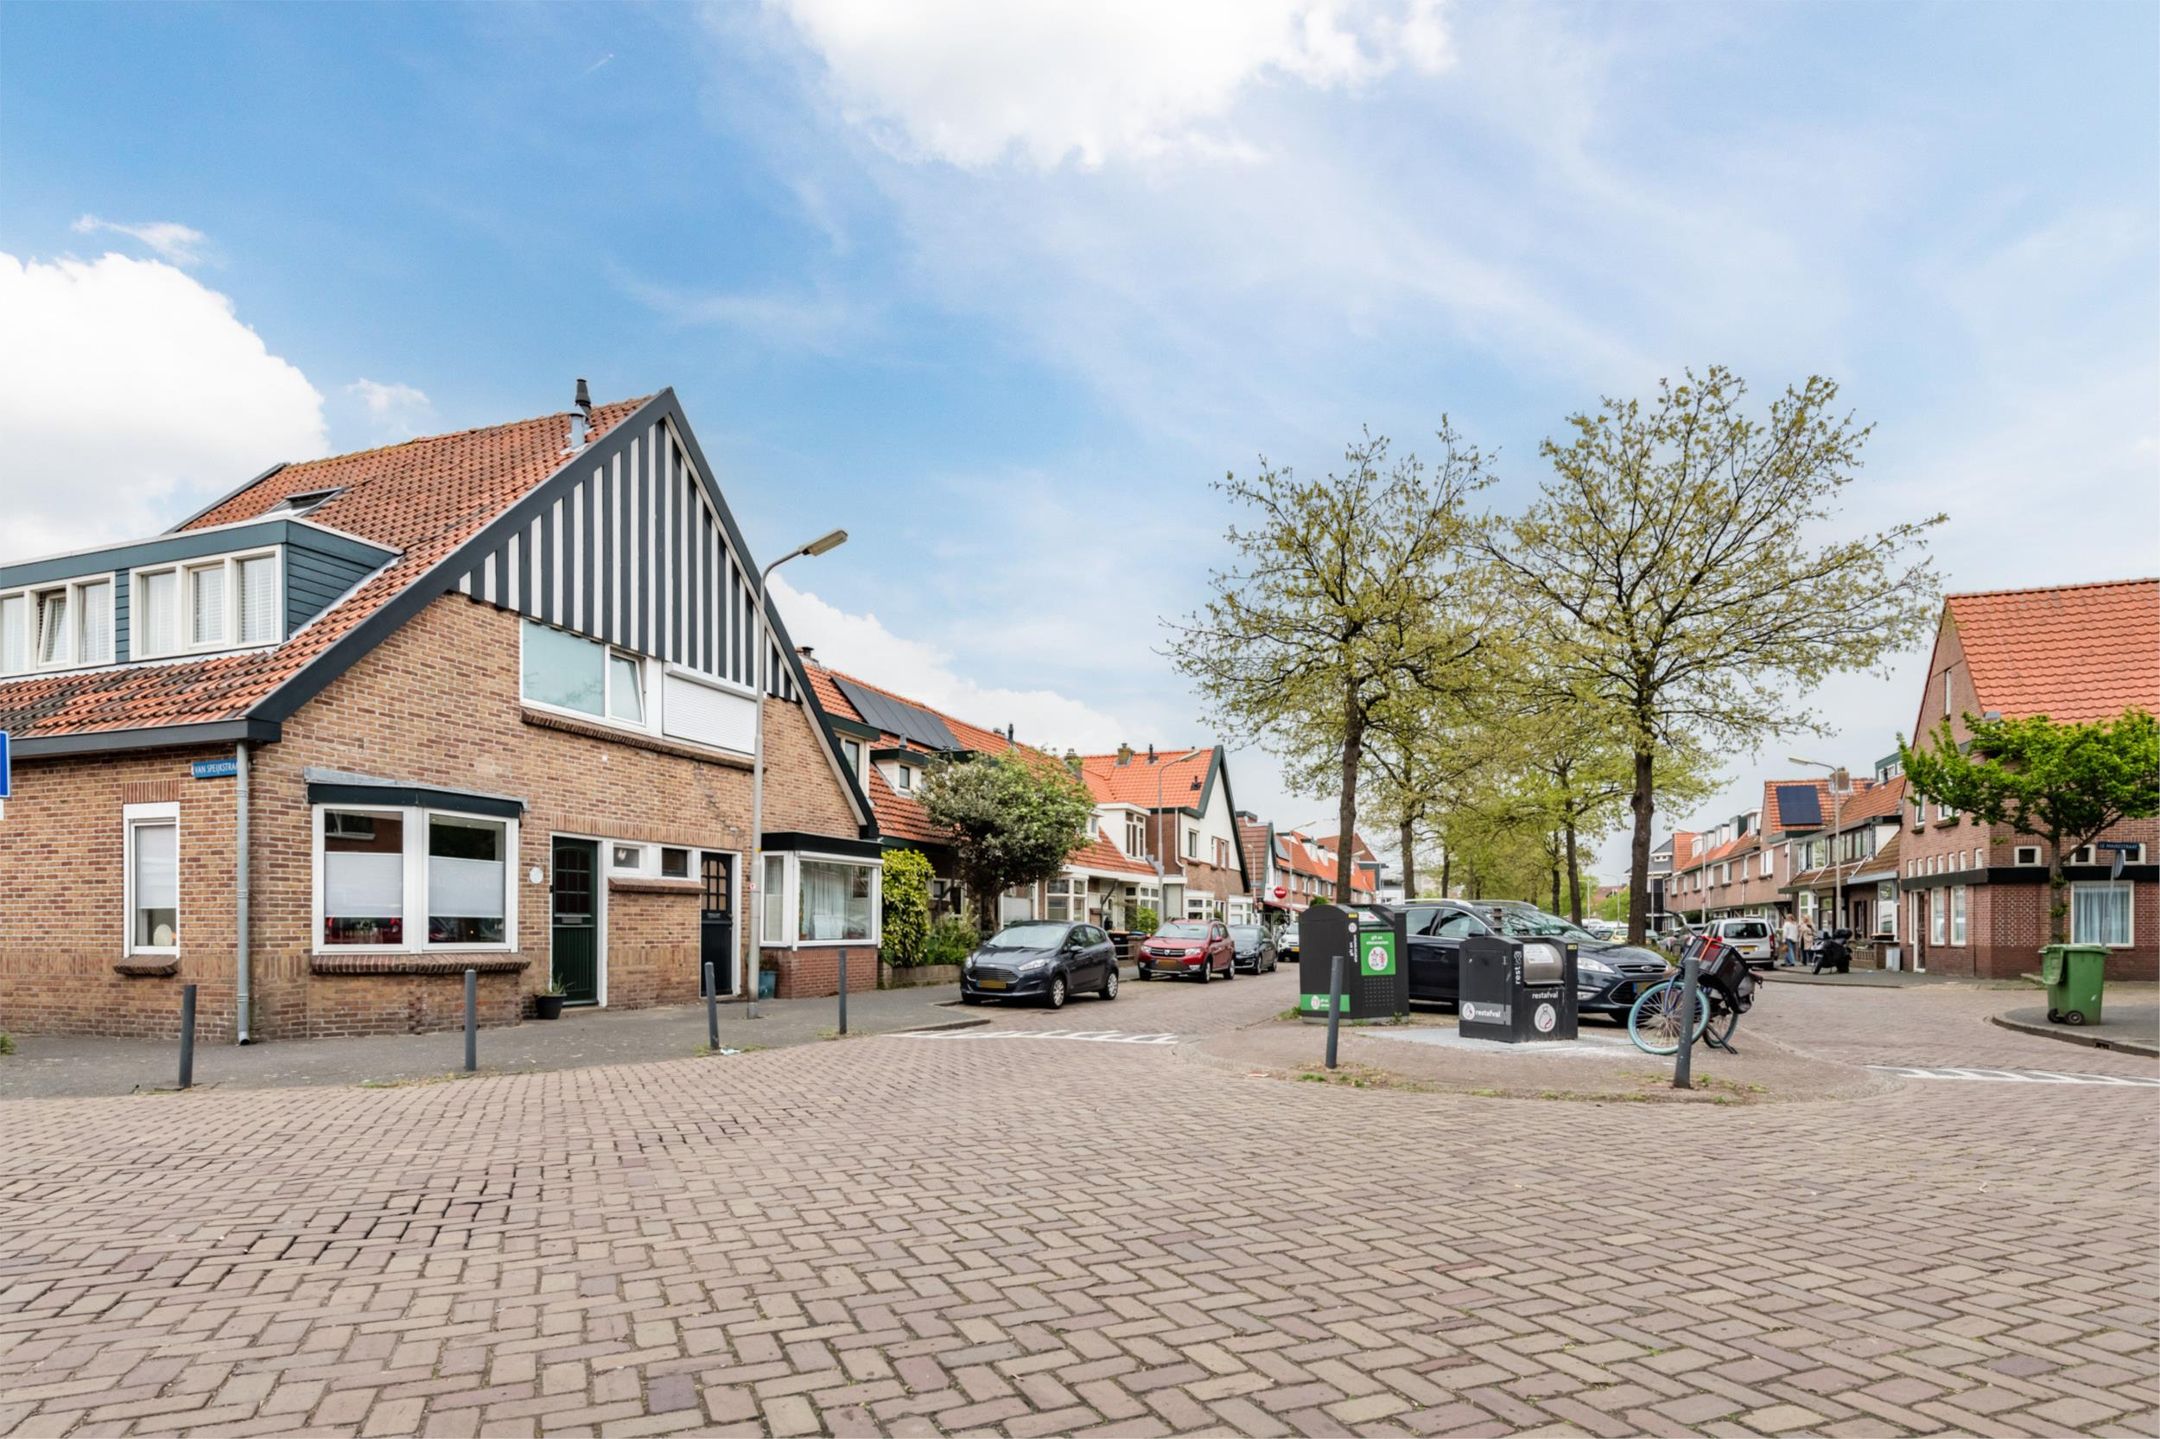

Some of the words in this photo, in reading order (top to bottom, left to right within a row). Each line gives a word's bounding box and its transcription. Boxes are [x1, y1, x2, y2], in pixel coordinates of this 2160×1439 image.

[194, 765, 206, 774] VAN
[1532, 991, 1559, 999] restafval
[1475, 1009, 1501, 1018] restafval
